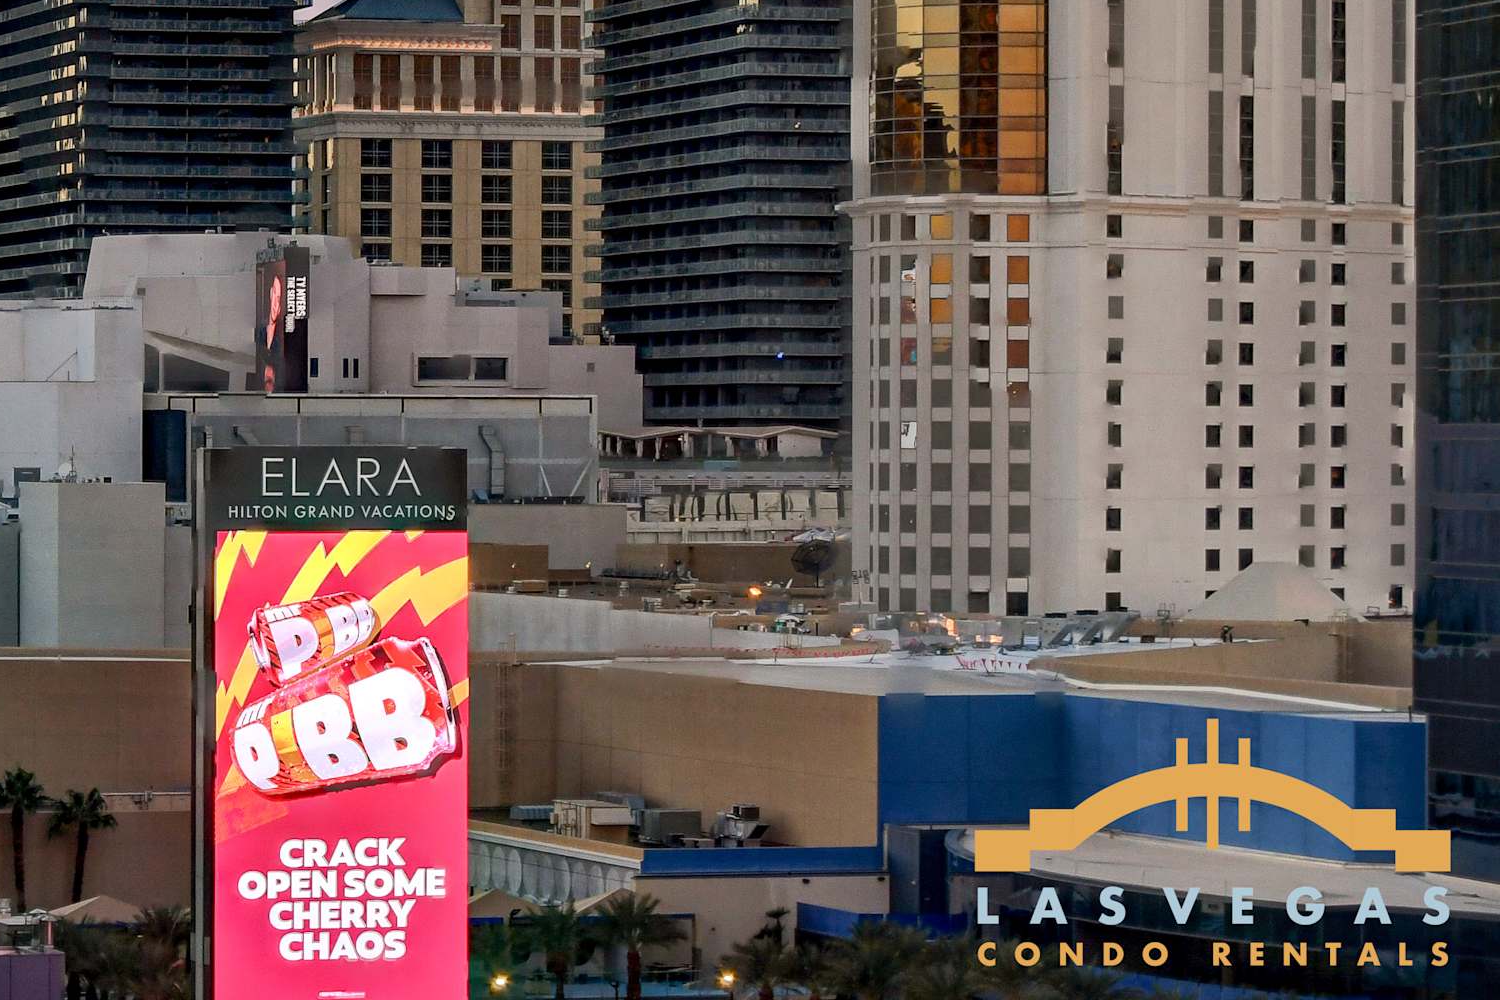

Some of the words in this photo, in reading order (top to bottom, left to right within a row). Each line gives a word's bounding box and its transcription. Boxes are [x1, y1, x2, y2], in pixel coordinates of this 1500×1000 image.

[296, 276, 306, 288] TY
[296, 288, 306, 317] MYERS
[261, 457, 422, 497] ELARA
[228, 505, 288, 519] HILTON
[294, 505, 355, 519] GRAND
[361, 505, 456, 521] VACATIONS
[279, 837, 406, 868] CRACK
[237, 869, 338, 900] OPEN
[343, 868, 447, 898] SOME
[268, 899, 417, 930] CHERRY
[278, 930, 407, 962] CHAOS
